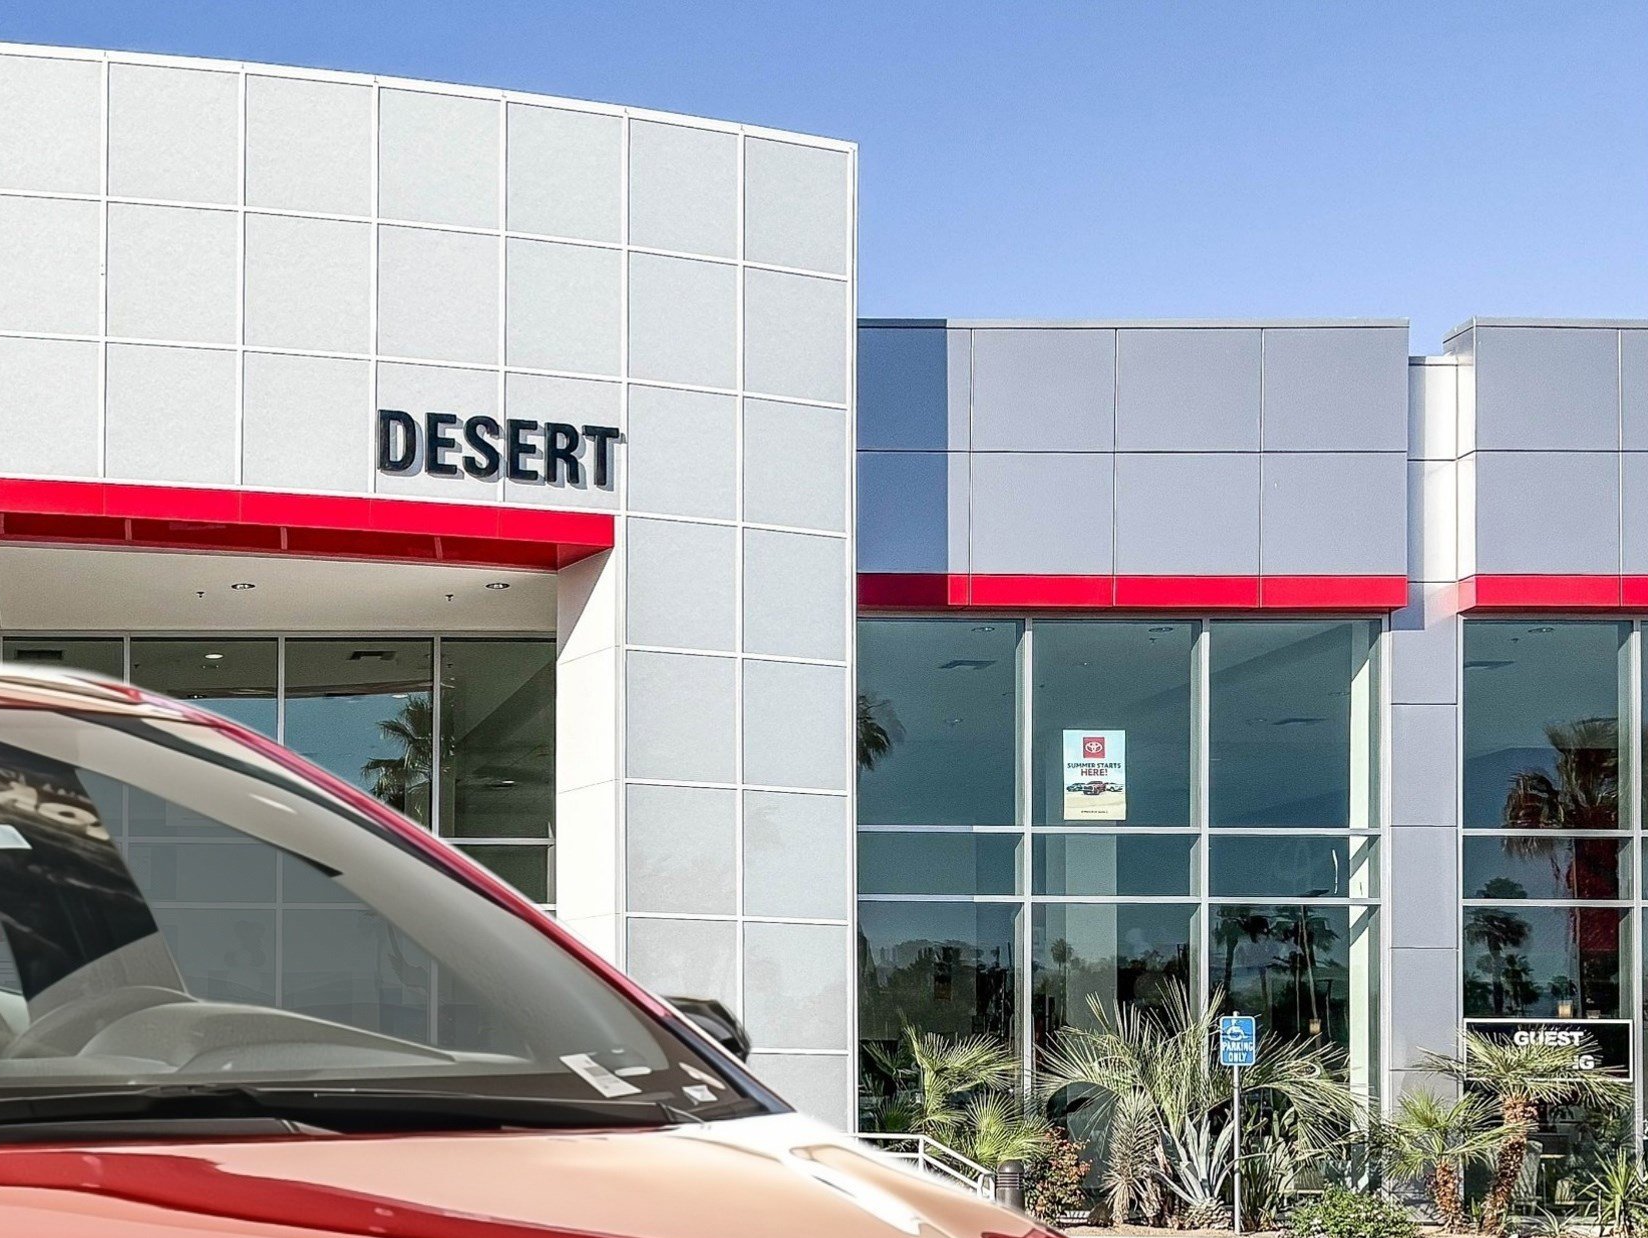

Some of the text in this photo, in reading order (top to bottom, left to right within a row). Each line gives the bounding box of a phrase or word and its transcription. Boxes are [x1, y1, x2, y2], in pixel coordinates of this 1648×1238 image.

[377, 409, 621, 487] DESERT
[1080, 768, 1108, 776] HERE!
[1513, 1030, 1584, 1047] GUEST
[1222, 1041, 1253, 1051] PARKING
[1228, 1052, 1247, 1062] ONLY
